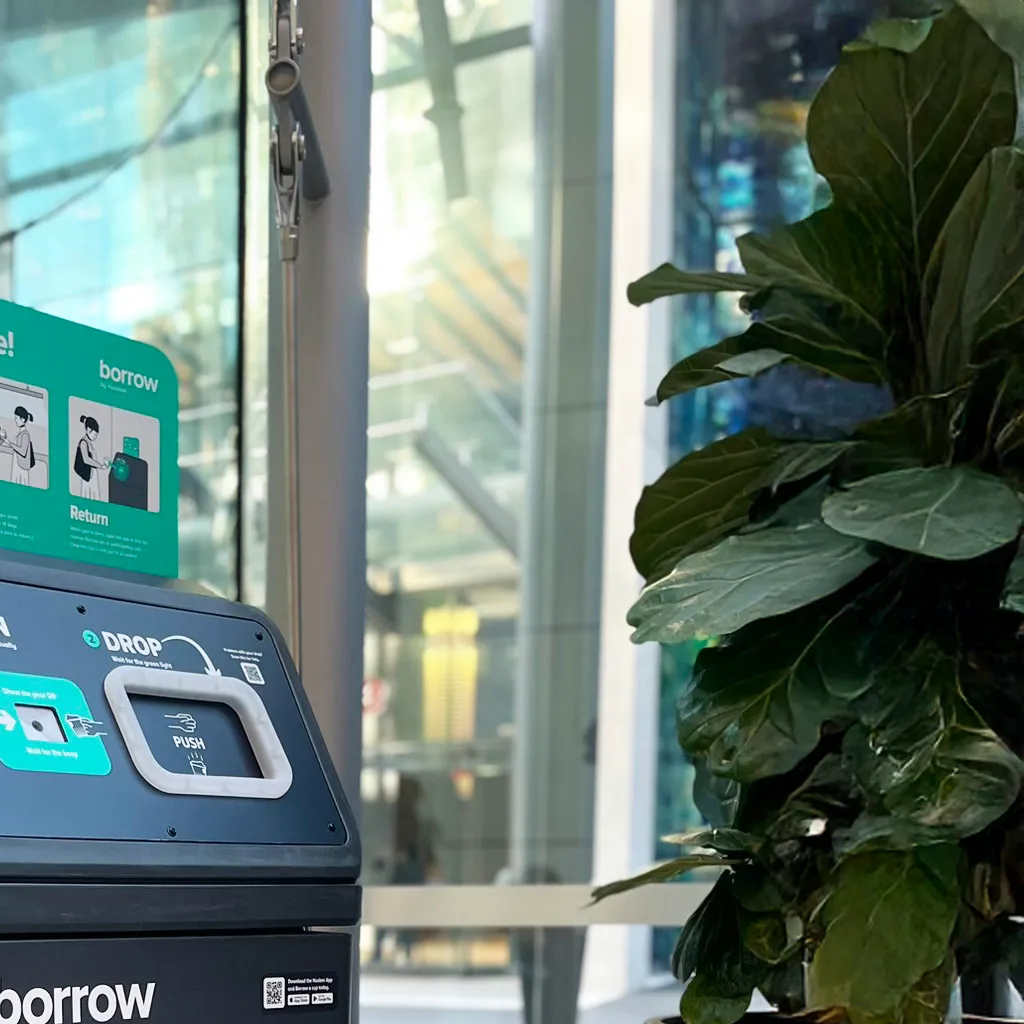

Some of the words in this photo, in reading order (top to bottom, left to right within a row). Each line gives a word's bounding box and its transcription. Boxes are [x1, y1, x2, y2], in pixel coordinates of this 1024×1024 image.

[99, 359, 159, 392] borrow
[70, 504, 109, 526] Return
[87, 634, 96, 644] 2
[101, 630, 163, 657] DROP
[110, 655, 125, 663] Wait
[144, 660, 160, 668] green
[159, 661, 173, 670] light
[25, 746, 42, 755] Wait
[172, 735, 206, 750] PUSH
